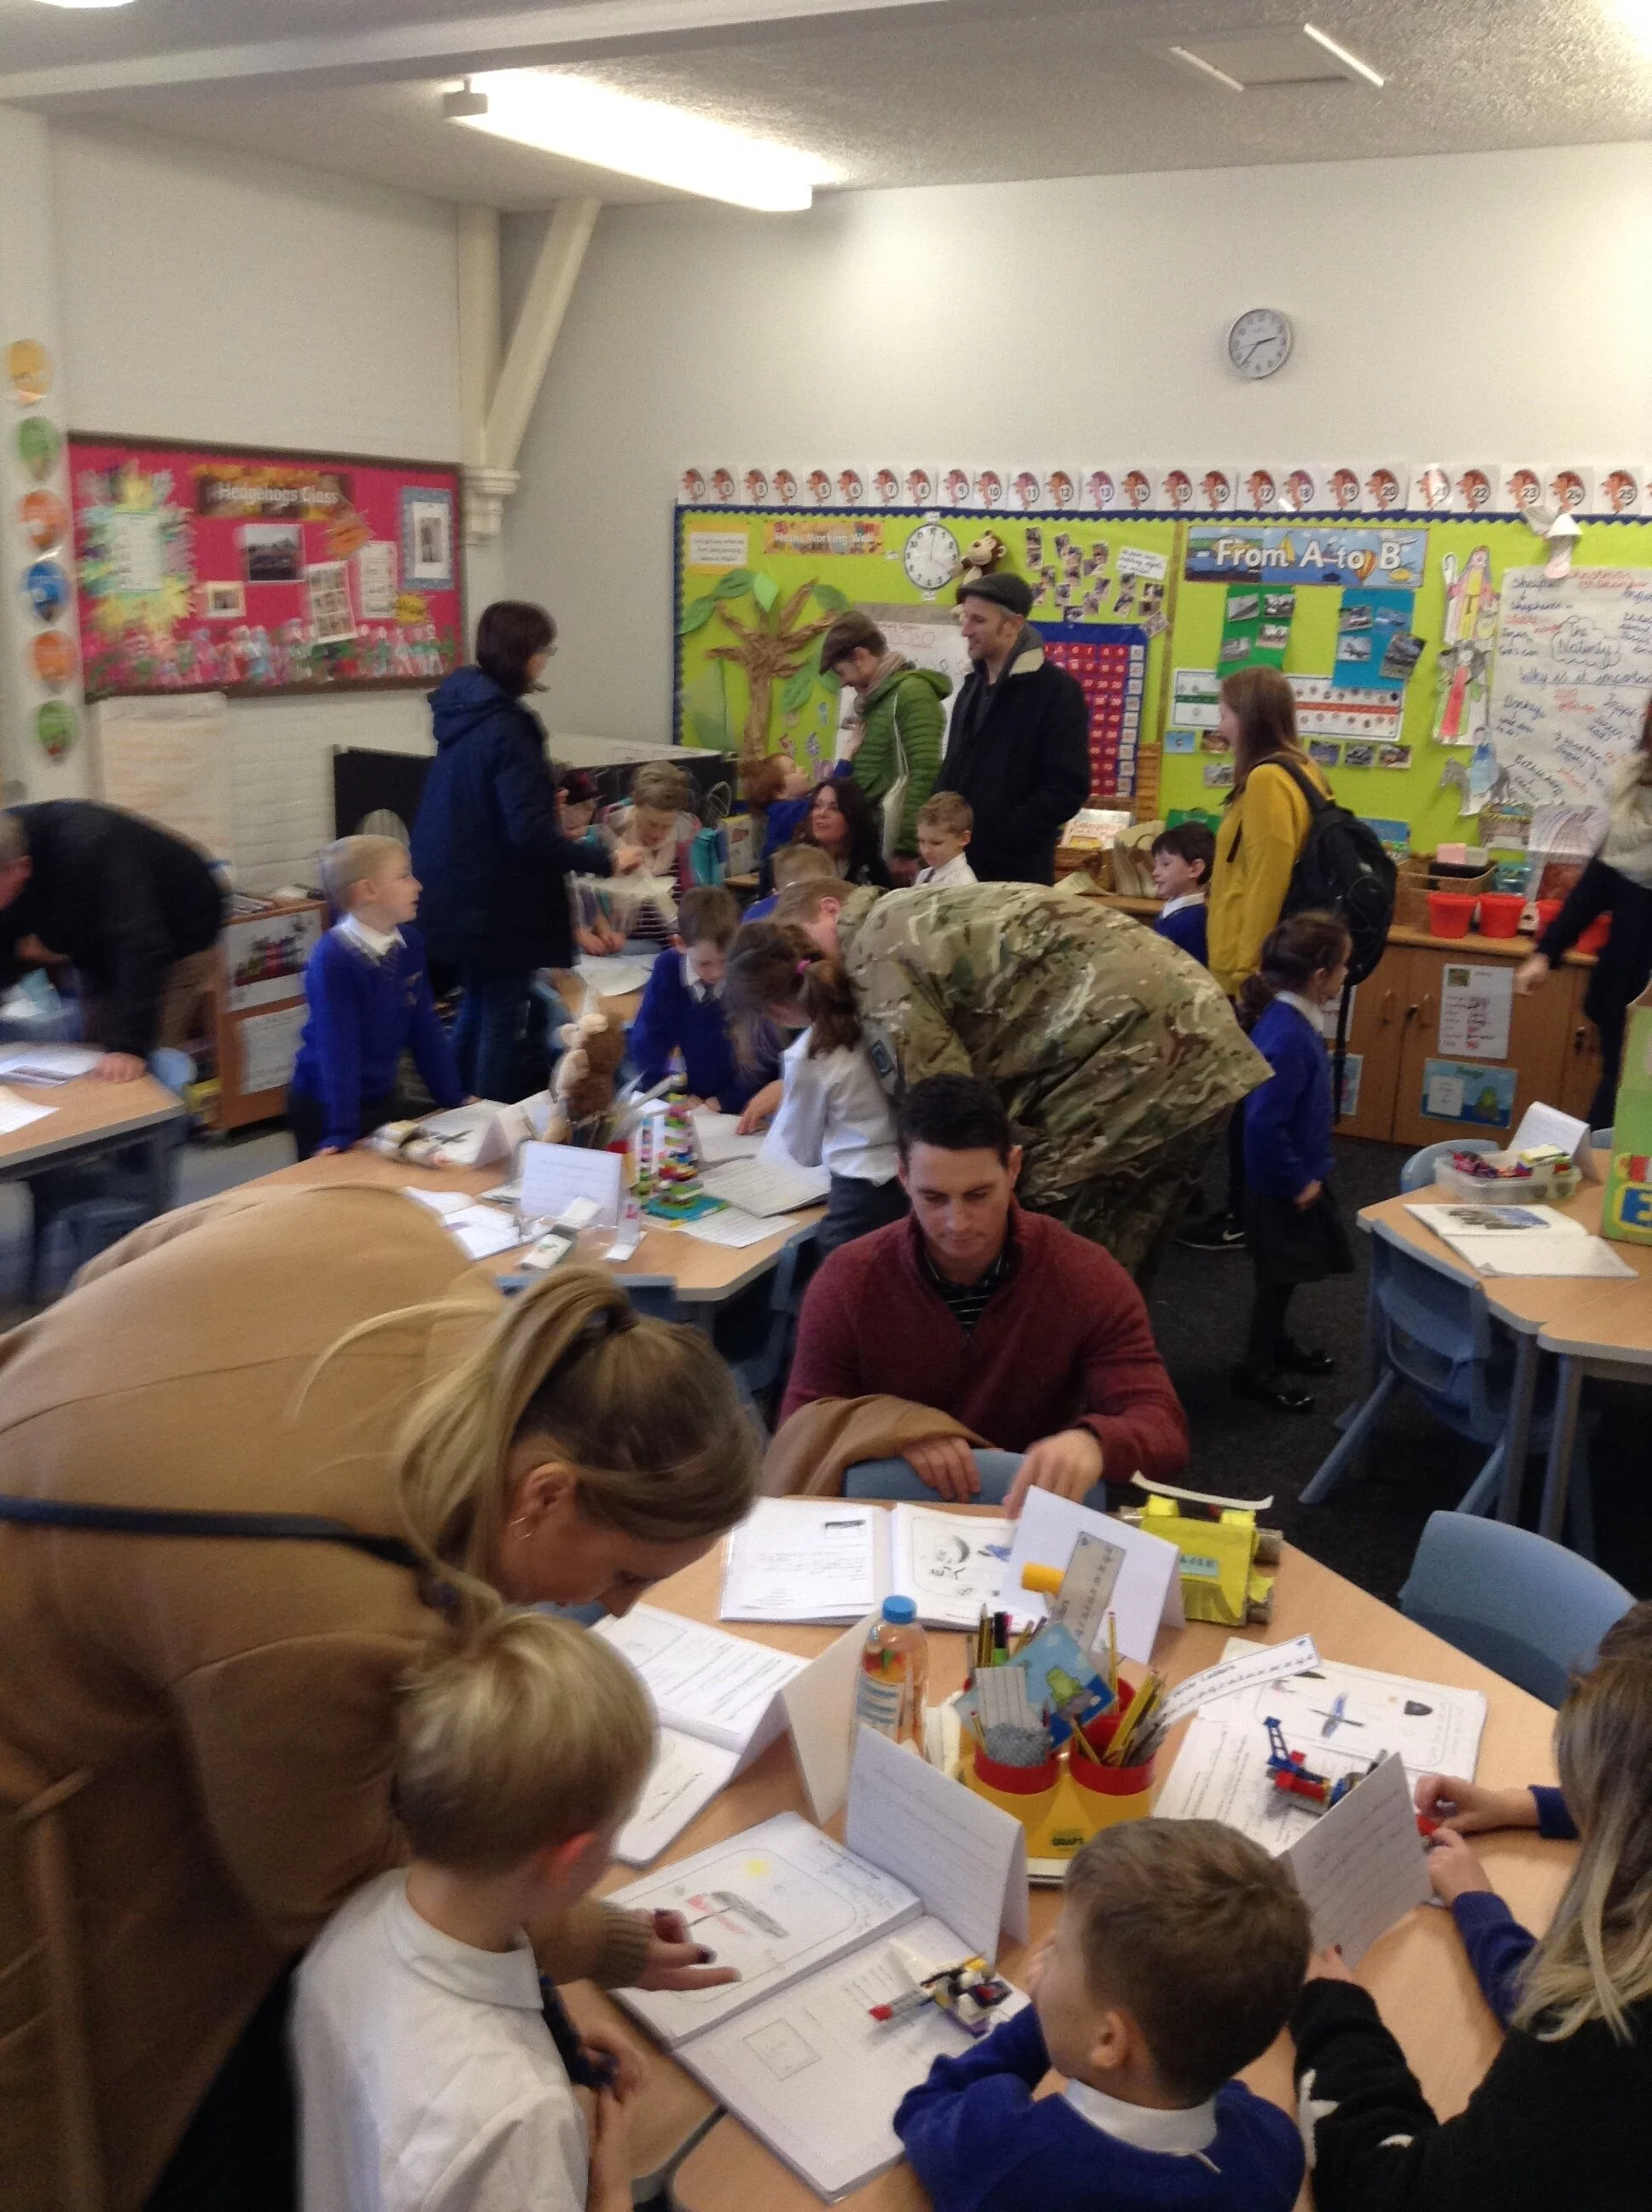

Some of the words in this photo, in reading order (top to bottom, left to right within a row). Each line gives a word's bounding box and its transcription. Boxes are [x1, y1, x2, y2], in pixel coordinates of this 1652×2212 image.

[300, 485, 340, 505] Class
[989, 486, 998, 496] 10
[1027, 488, 1037, 497] 11
[1061, 487, 1070, 497] 12
[1101, 487, 1110, 497] 13
[1137, 487, 1147, 497] 14
[1178, 487, 1188, 497] 15
[1215, 488, 1225, 497] 16
[1260, 487, 1271, 497] 17
[1300, 488, 1310, 497] 18
[1344, 487, 1355, 497] 19
[1382, 486, 1395, 496] 20
[1473, 488, 1486, 497] 22
[1522, 488, 1536, 497] 23
[1568, 490, 1579, 498] 24
[1620, 490, 1633, 499] 25
[1217, 538, 1289, 568] From
[1299, 540, 1324, 568] A
[1337, 549, 1366, 570] to
[1379, 542, 1402, 570] B
